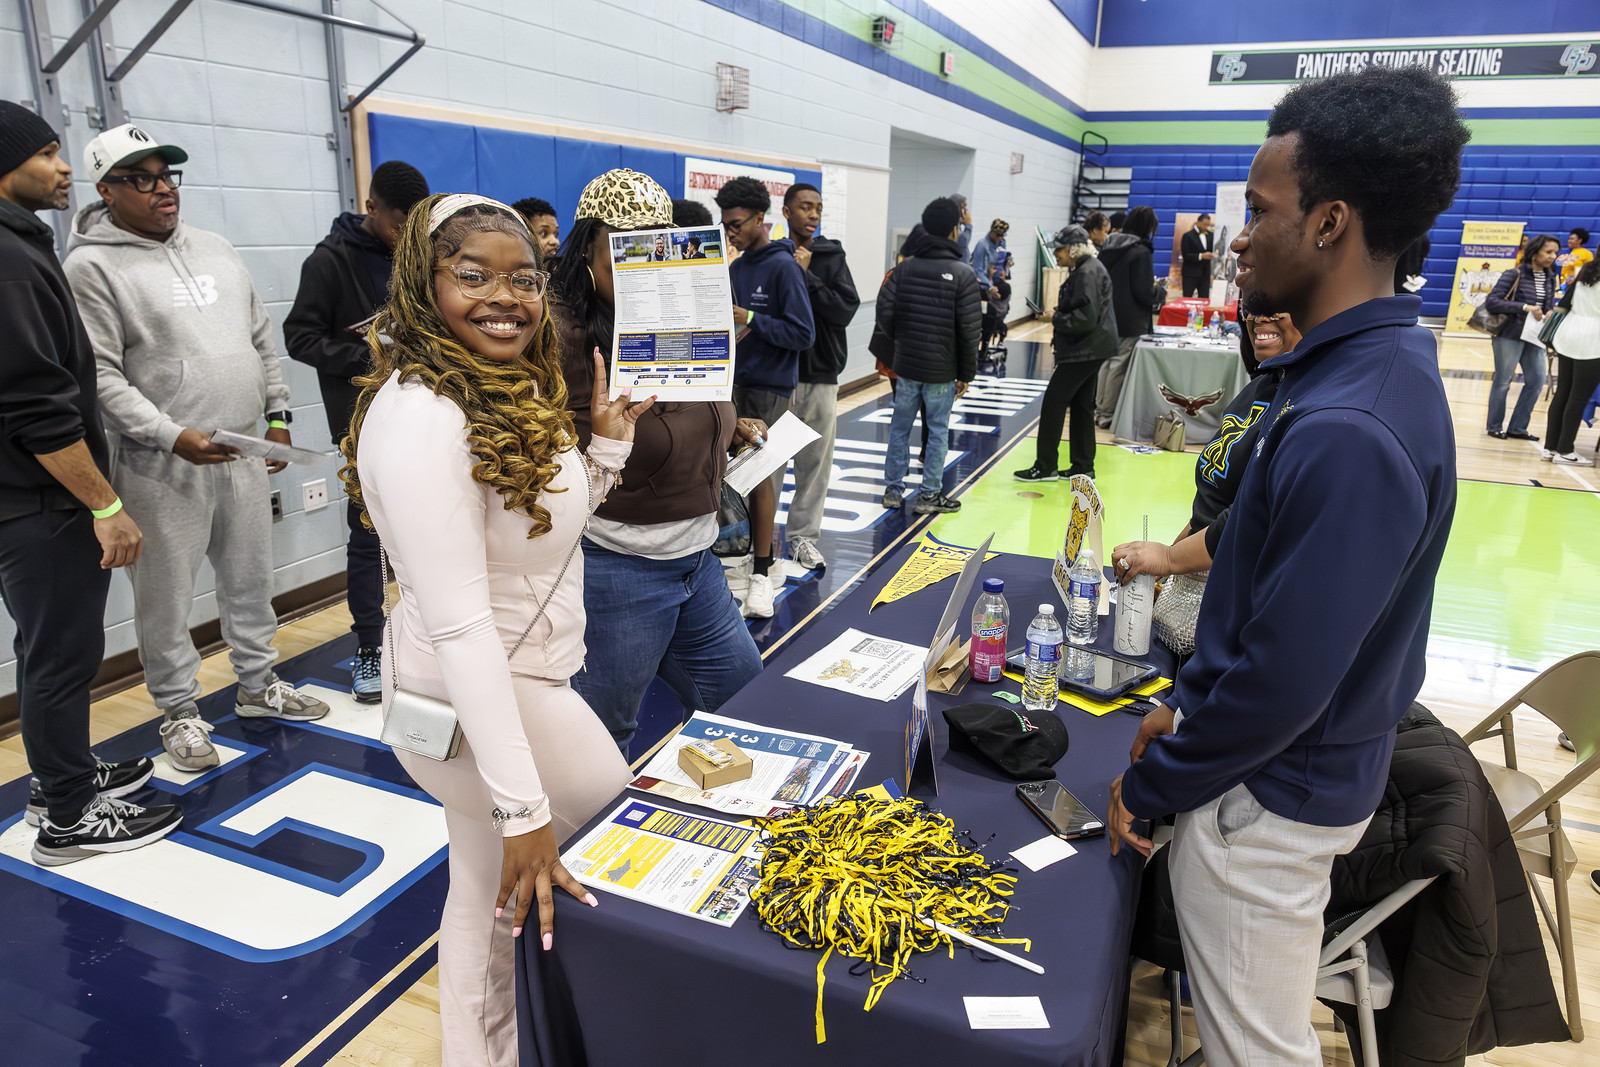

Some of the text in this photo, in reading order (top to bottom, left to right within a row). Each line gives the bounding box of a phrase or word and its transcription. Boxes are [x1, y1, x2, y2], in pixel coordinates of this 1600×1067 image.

[1295, 48, 1503, 79] PANTHERS STUDENT SEATING
[632, 181, 664, 214] NY
[980, 625, 1006, 637] snapple
